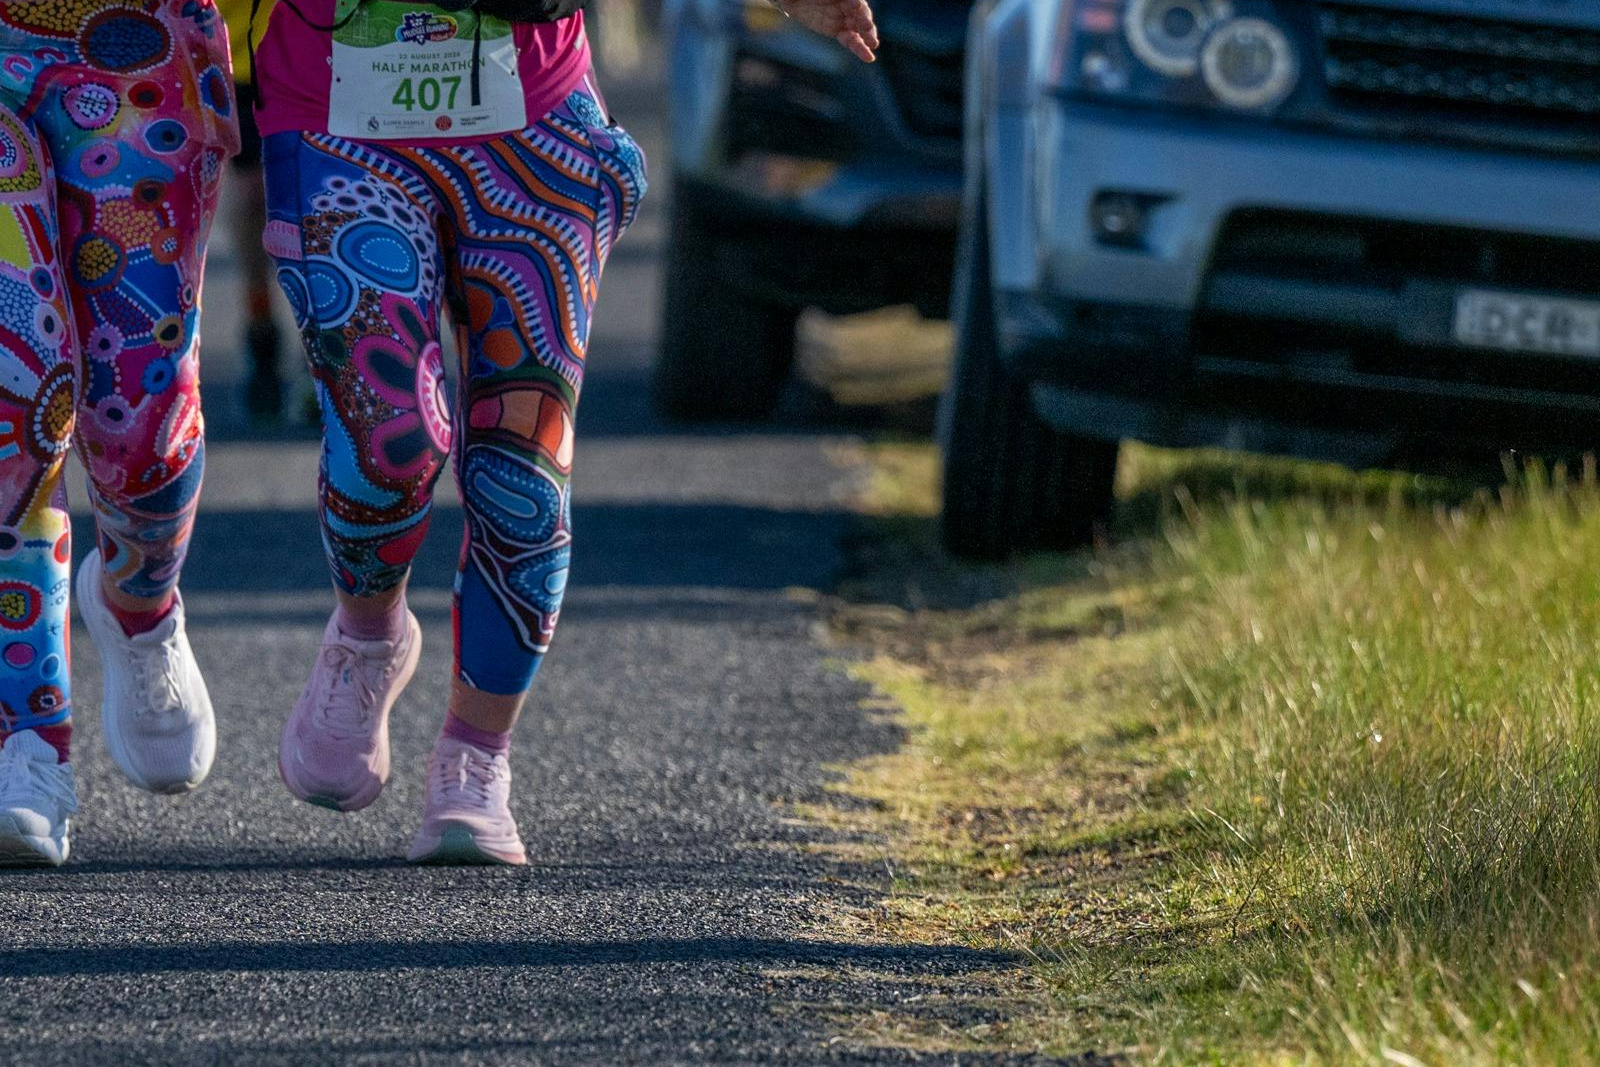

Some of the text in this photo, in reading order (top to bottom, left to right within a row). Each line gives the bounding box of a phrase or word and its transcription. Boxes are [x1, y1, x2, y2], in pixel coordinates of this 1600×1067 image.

[410, 52, 441, 60] AUGUST
[372, 61, 405, 73] HALF
[391, 75, 462, 112] 407
